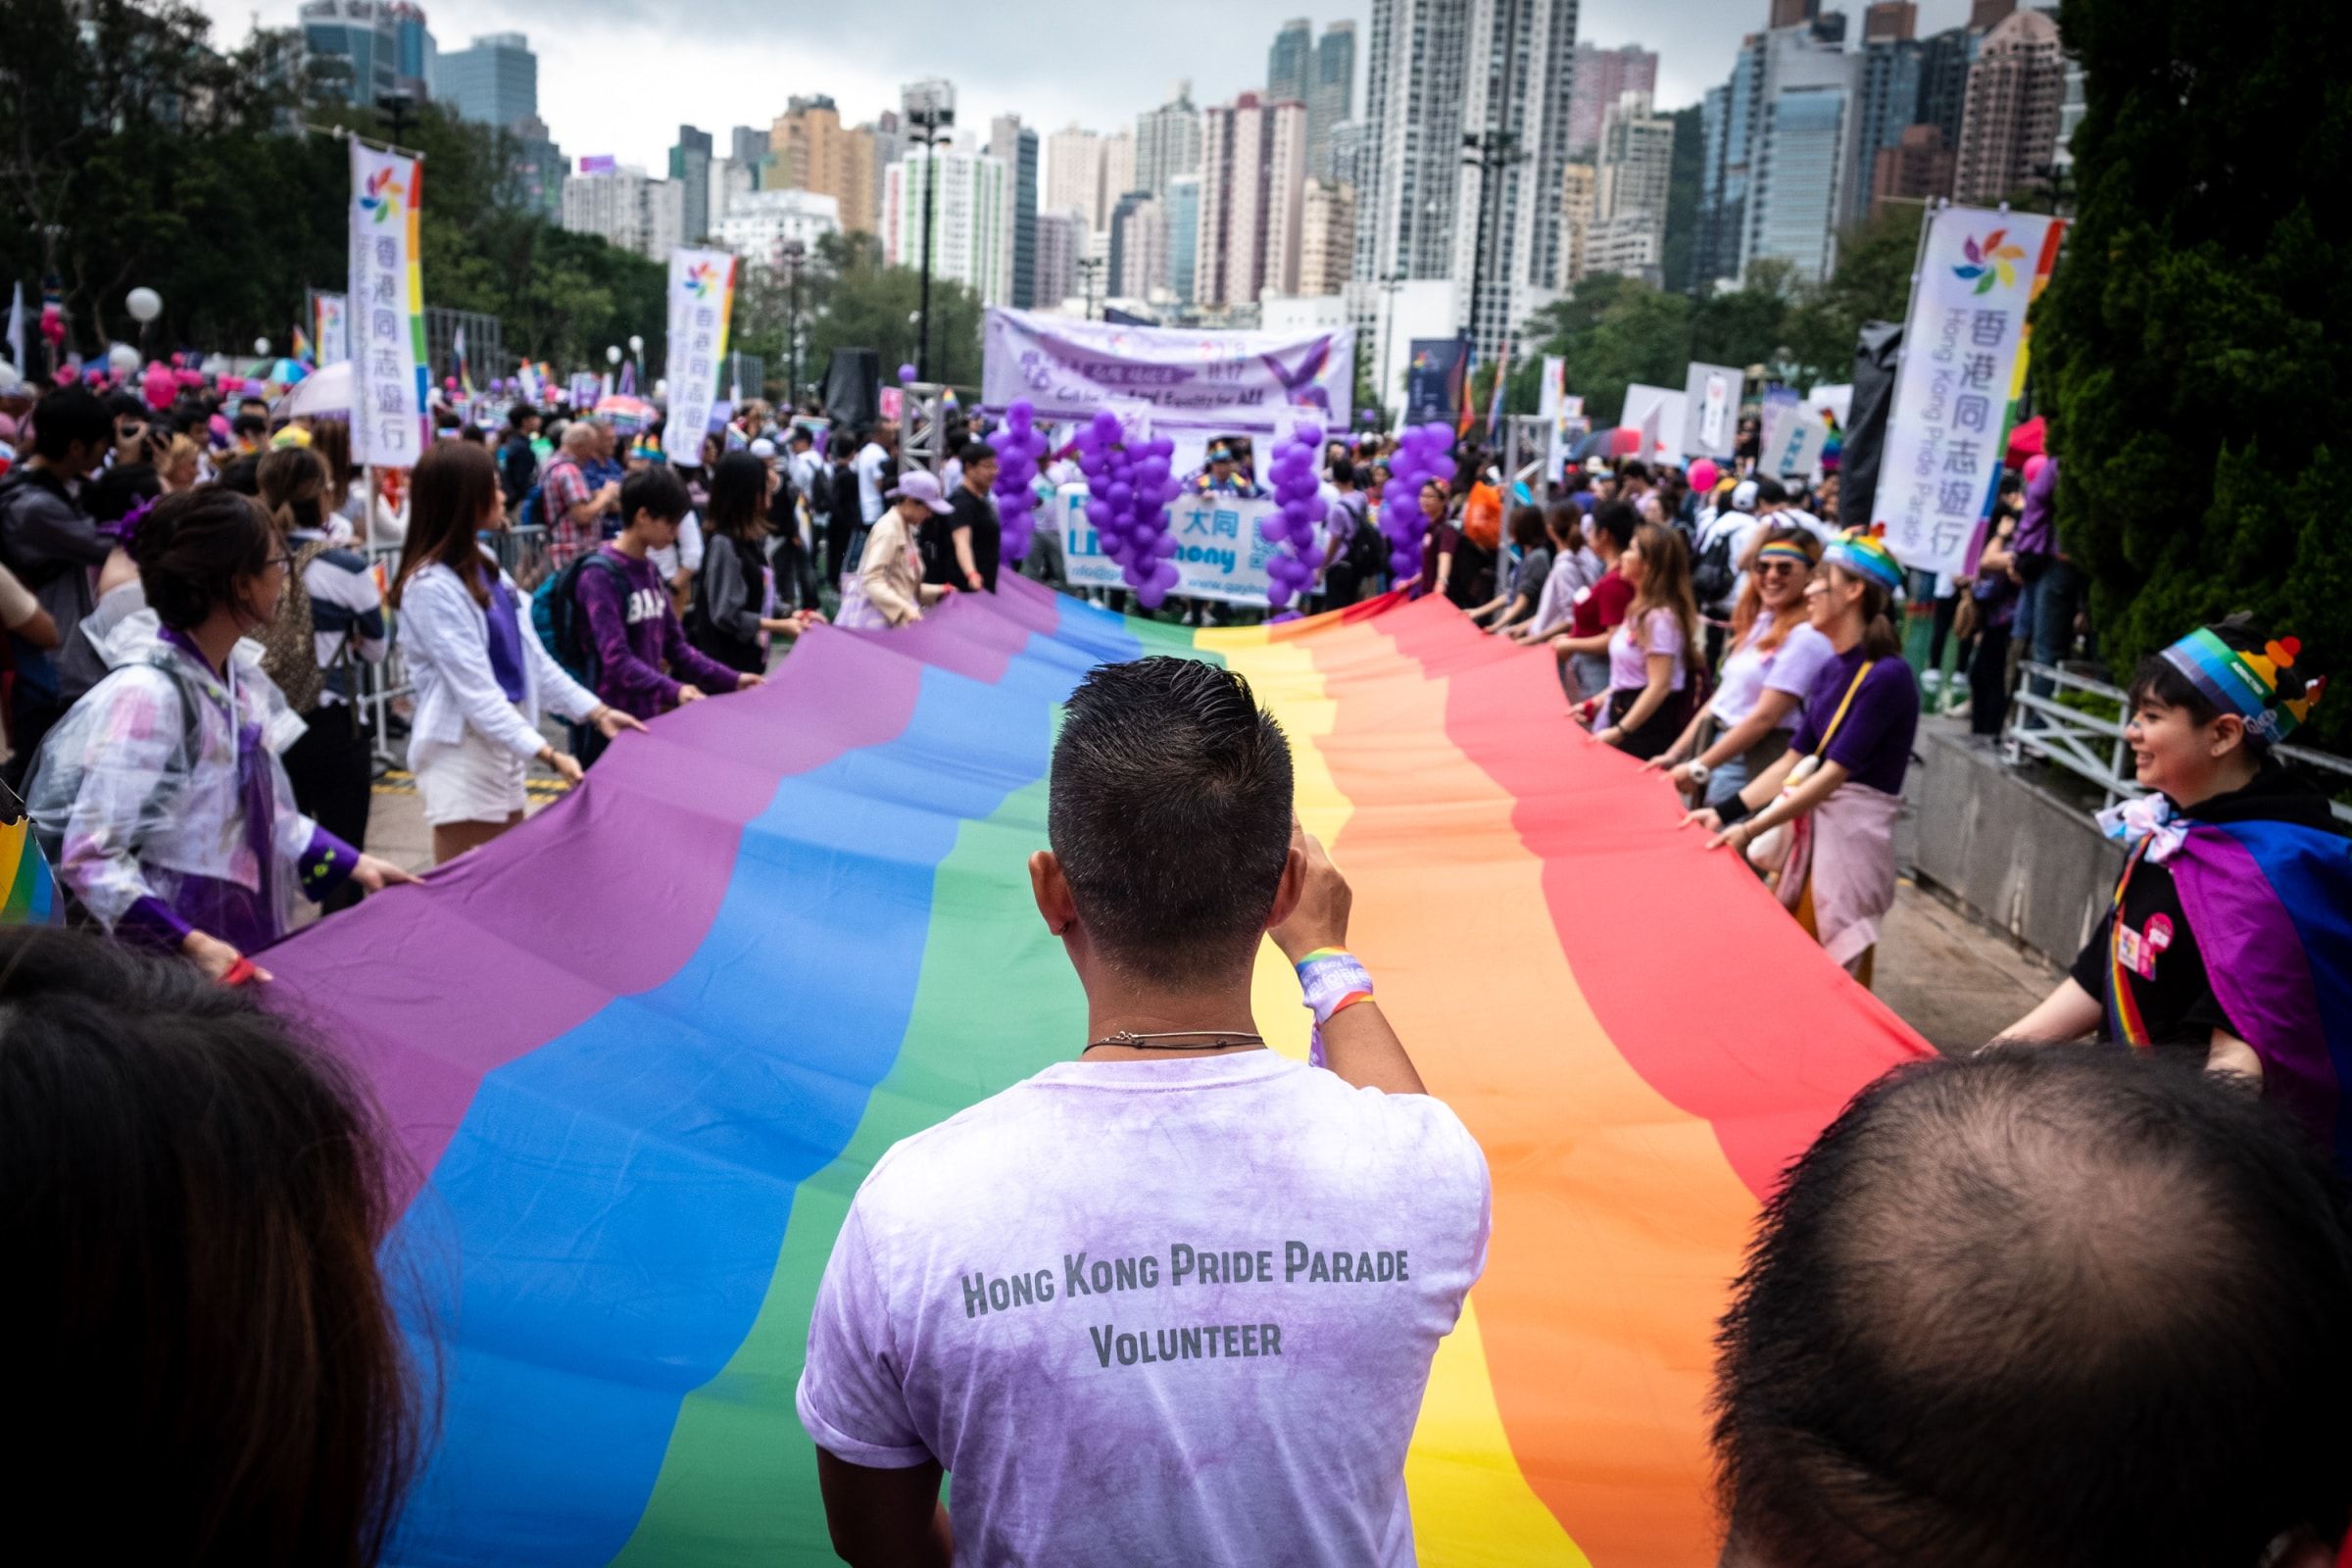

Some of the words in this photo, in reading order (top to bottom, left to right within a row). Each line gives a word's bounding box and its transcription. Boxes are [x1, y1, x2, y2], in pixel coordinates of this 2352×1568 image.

[1932, 307, 1968, 363] Hong
[1921, 368, 1958, 421] Kong
[1915, 425, 1944, 477] Pride
[1931, 308, 2009, 558] 香港同志遊行
[1183, 508, 1239, 539] 大同
[1902, 482, 1934, 548] Parade
